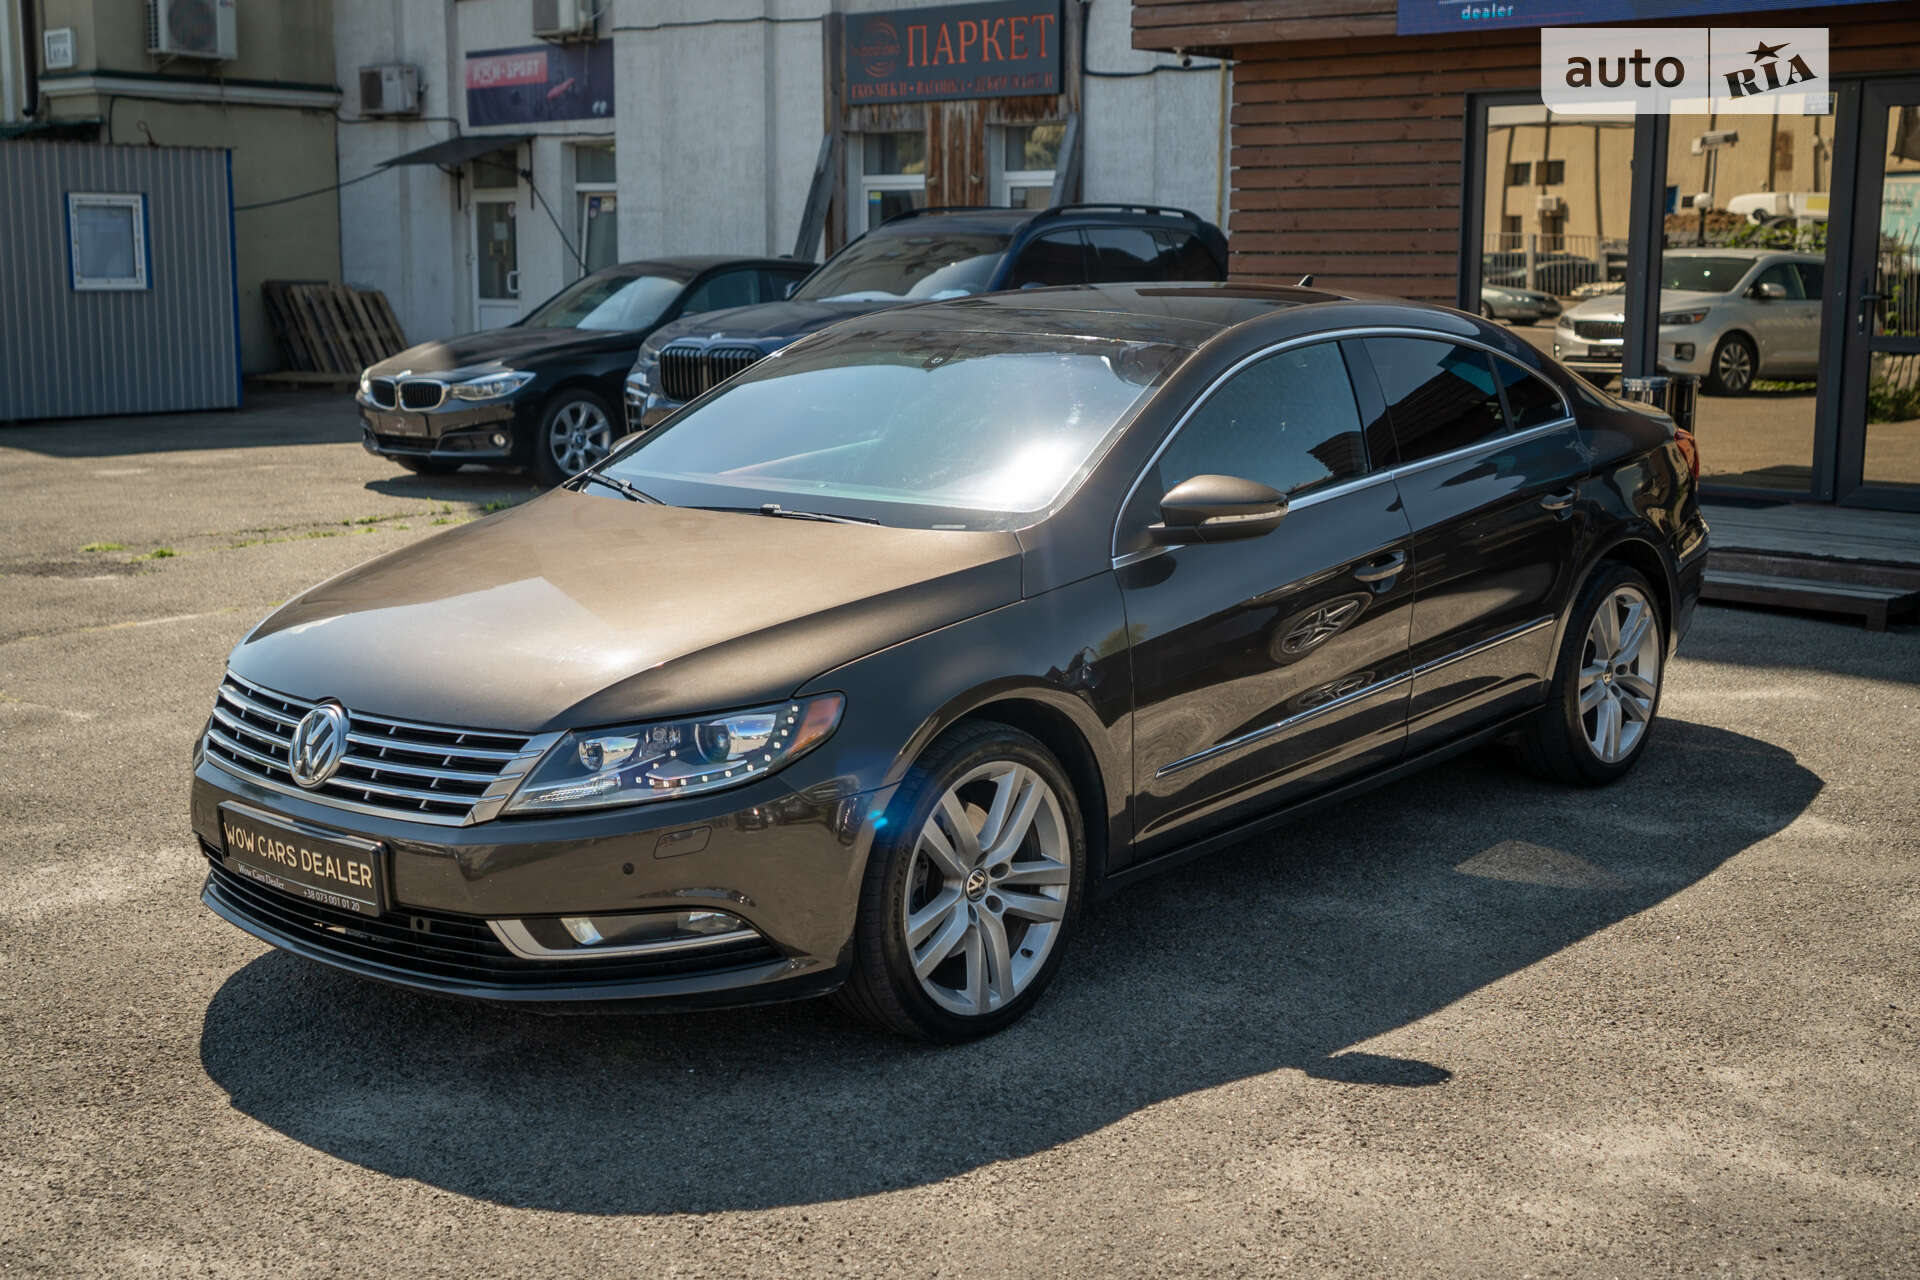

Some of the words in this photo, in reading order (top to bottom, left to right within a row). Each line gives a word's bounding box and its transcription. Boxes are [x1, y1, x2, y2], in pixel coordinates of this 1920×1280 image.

[1461, 3, 1513, 20] dealer
[907, 14, 1055, 67] ПАРКЕТ
[223, 822, 255, 853] WOW
[257, 836, 298, 868] CARS
[300, 849, 373, 889] DEALER
[265, 875, 285, 890] Dealer
[303, 888, 315, 900] +38
[315, 891, 328, 903] 073
[328, 895, 340, 906] 001
[341, 898, 350, 909] 01
[351, 901, 360, 912] 20
